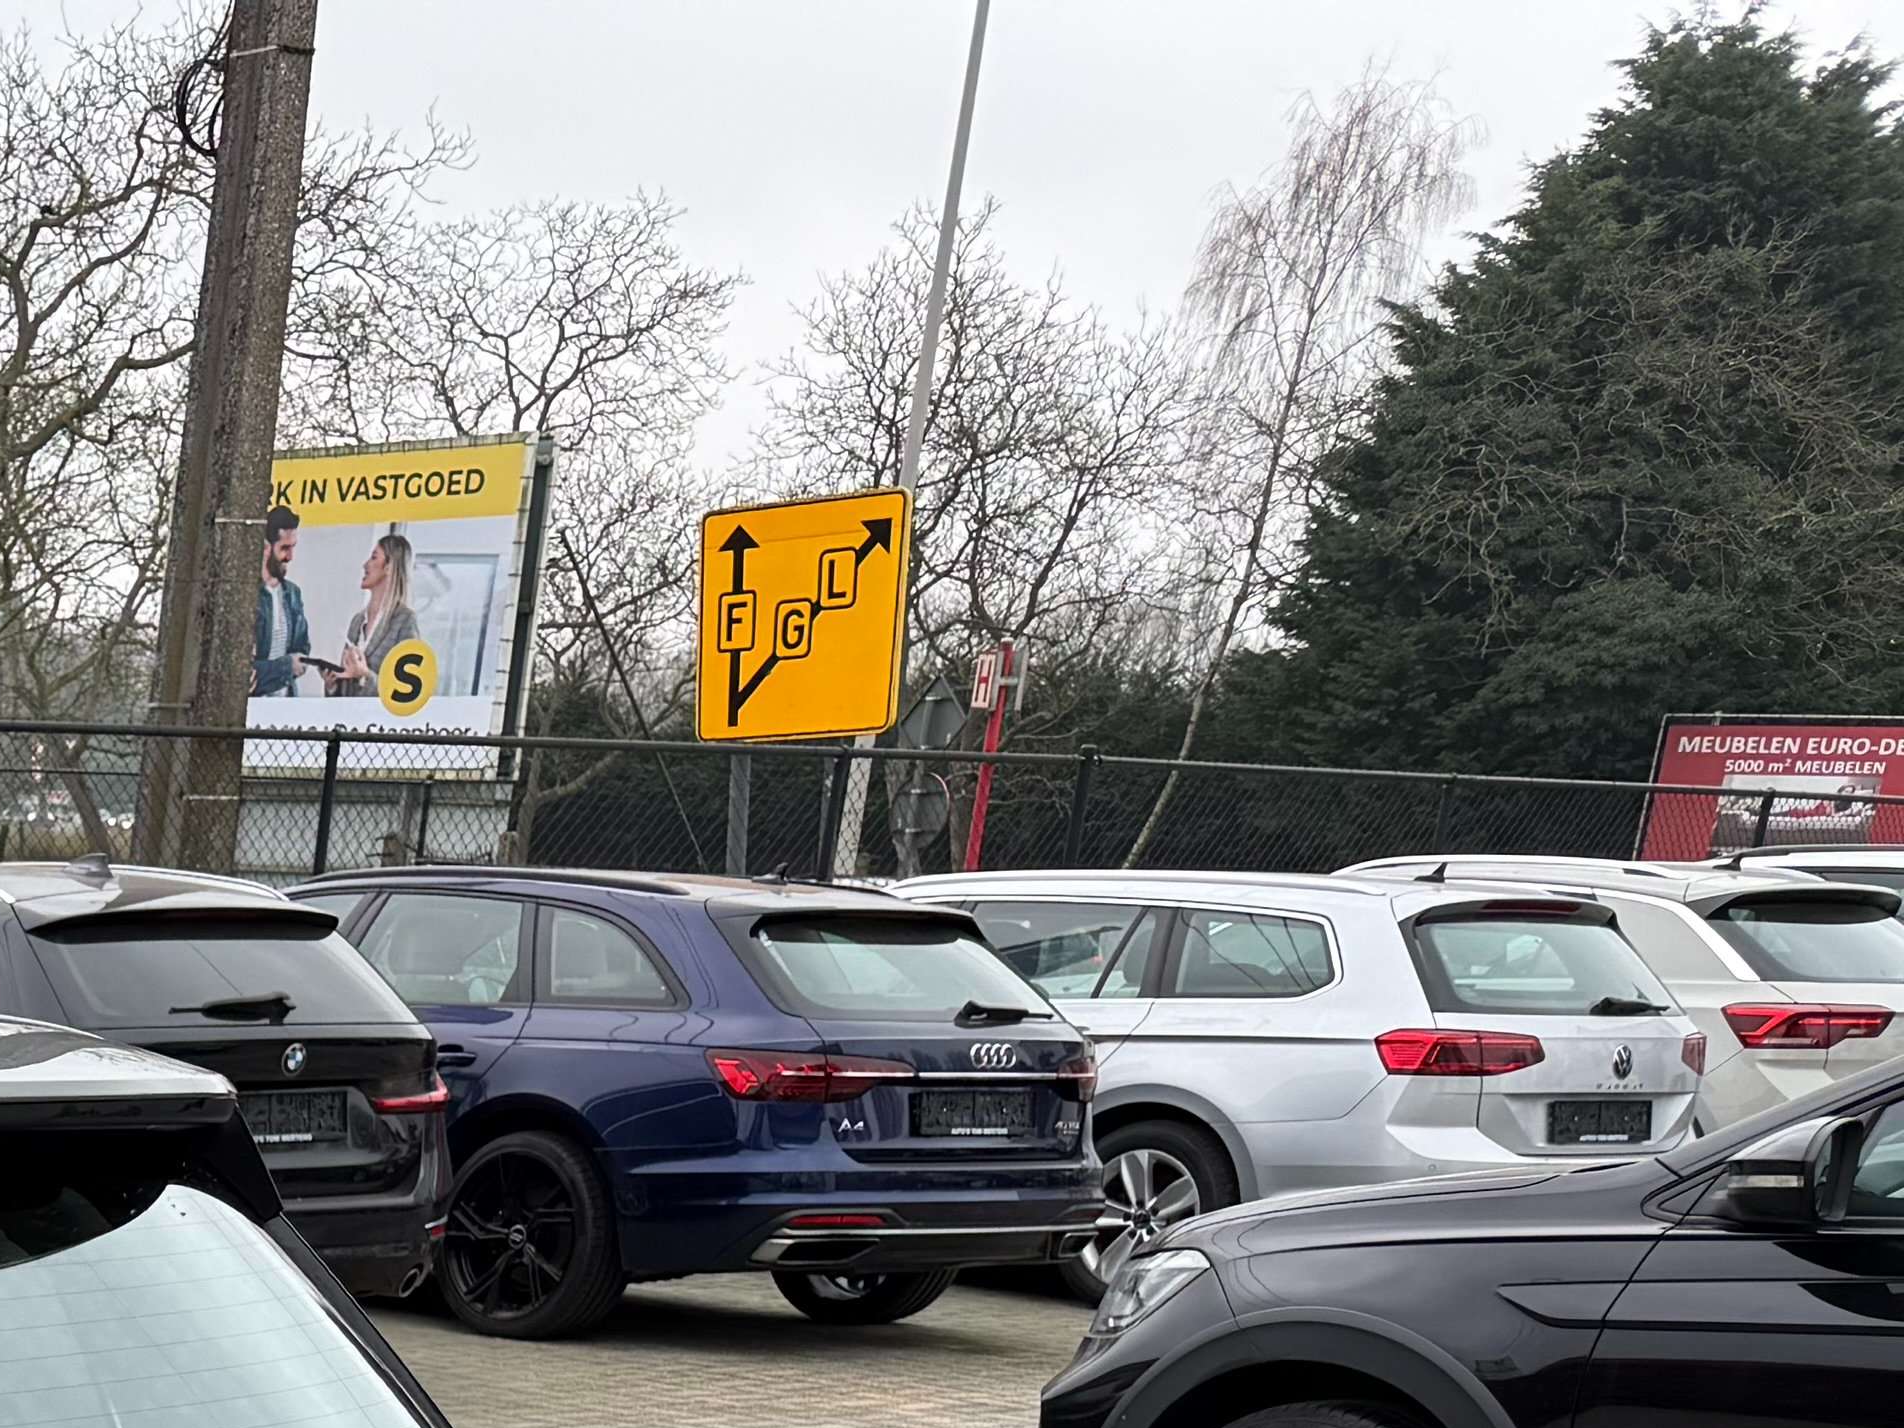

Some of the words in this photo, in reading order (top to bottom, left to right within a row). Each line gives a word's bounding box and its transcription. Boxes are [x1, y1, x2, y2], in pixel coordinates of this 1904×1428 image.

[300, 478, 327, 505] IN
[336, 468, 485, 502] VASTGOED
[827, 559, 847, 599] L
[726, 601, 748, 642] F
[781, 609, 805, 650] G
[390, 653, 424, 704] S
[1678, 736, 1802, 754] MEUBELEN
[1724, 759, 1763, 773] 5000
[1794, 760, 1886, 774] MEUBELEN
